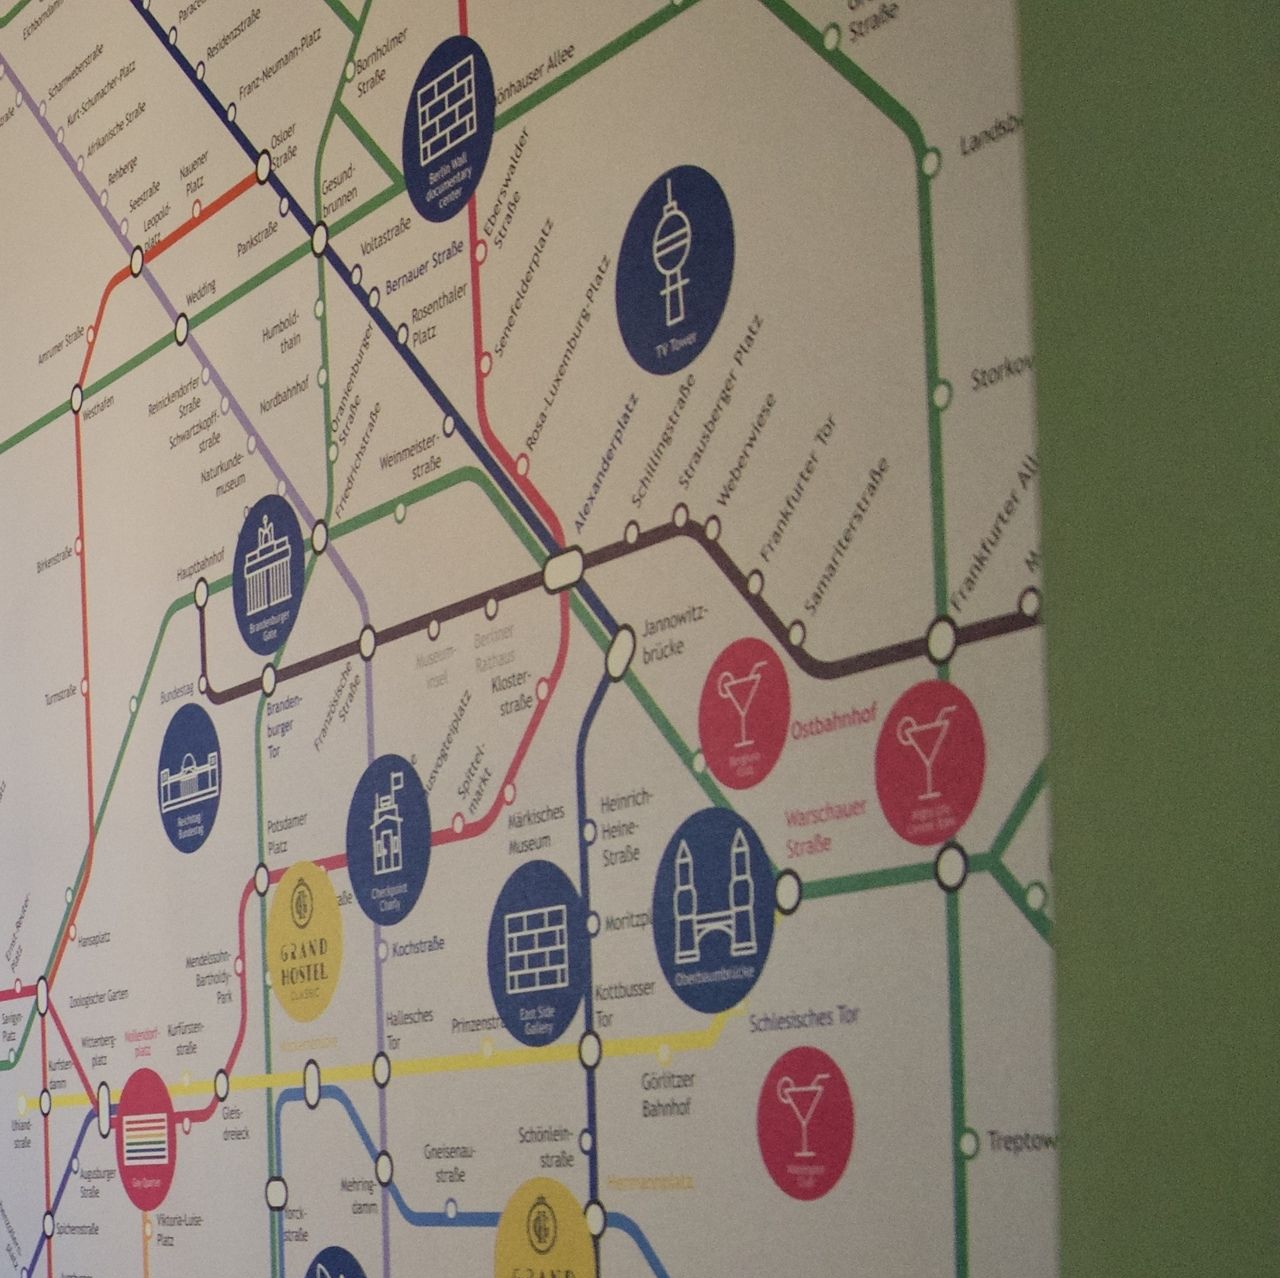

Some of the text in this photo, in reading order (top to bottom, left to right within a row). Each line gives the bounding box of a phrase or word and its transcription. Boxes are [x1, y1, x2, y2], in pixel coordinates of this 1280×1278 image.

[206, 8, 261, 61] Residenzstraße
[239, 27, 322, 101] Franz-Neumann-Platz
[355, 28, 408, 75] Bornholmer
[547, 43, 575, 71] Allee
[357, 67, 386, 99] Straße
[270, 122, 296, 149] Osloer
[108, 156, 138, 186] Rehberge
[179, 151, 209, 180] Nauener
[271, 144, 298, 171] Straße
[186, 176, 204, 197] Platz
[321, 166, 356, 196] Gesund-
[483, 127, 529, 237] Eberswalder
[129, 181, 161, 213] Seestraße
[323, 187, 358, 218] brunnen
[143, 205, 171, 232] Leopold-
[494, 191, 521, 249] Straße
[237, 221, 278, 257] Pankstraße
[361, 217, 411, 256] Voltastraße
[386, 240, 464, 295] Bernauer Straße
[186, 279, 216, 307] Wedding
[494, 218, 555, 357] Senefelderplatz
[411, 283, 468, 324] Rosenthaler
[280, 332, 301, 354] thain
[412, 324, 438, 348] Platz
[525, 254, 611, 452] Rosa-Luxemburg-Platz
[331, 321, 373, 433] Oranienburger
[179, 397, 201, 419] Straße
[259, 375, 309, 414] Nordbahnhof
[679, 314, 764, 491] Strausberger Platz
[631, 373, 696, 508] Schillingstraße
[717, 393, 776, 507] Weberwiese
[200, 453, 244, 483] Naturkunde-
[336, 401, 381, 519] Friedrichstraße
[573, 393, 639, 534] Alexanderplatz
[215, 473, 246, 497] museum
[760, 412, 838, 563] Frankfurter Tor
[805, 457, 891, 615] Samariterstraße
[950, 489, 1021, 612] Frankfurter
[642, 605, 709, 638] Jannowitz-
[642, 640, 685, 665] brücke
[492, 672, 532, 694] Kloster-
[267, 694, 302, 717] Branden-
[314, 662, 352, 751] Französische
[338, 673, 361, 722] Straße
[500, 694, 533, 717] straße
[267, 719, 294, 740] burger
[791, 701, 877, 741] Ostbahnhof
[268, 745, 280, 759] Tor
[457, 744, 487, 800] Spittel-
[469, 768, 492, 815] markt
[601, 789, 653, 814] Heinrich-
[268, 812, 308, 834] Potsdamer
[508, 805, 565, 830] Märkisches
[601, 822, 639, 841] Heine-
[268, 839, 288, 855] Platz
[509, 834, 551, 855] Museum
[602, 846, 640, 868] Straße
[280, 938, 328, 963] GRAND
[391, 936, 445, 959] Kochstraße
[281, 961, 329, 988] HOSTEL
[596, 979, 655, 1001] Kottbusser
[386, 1008, 434, 1028] Hallesches
[596, 1010, 613, 1029] Tor
[837, 1004, 860, 1025] Tor
[387, 1035, 401, 1050] Tor
[642, 1071, 695, 1092] Görlitzer
[642, 1098, 691, 1119] Bahnhof
[518, 1126, 573, 1144] Schönlein-
[540, 1152, 574, 1169] straße
